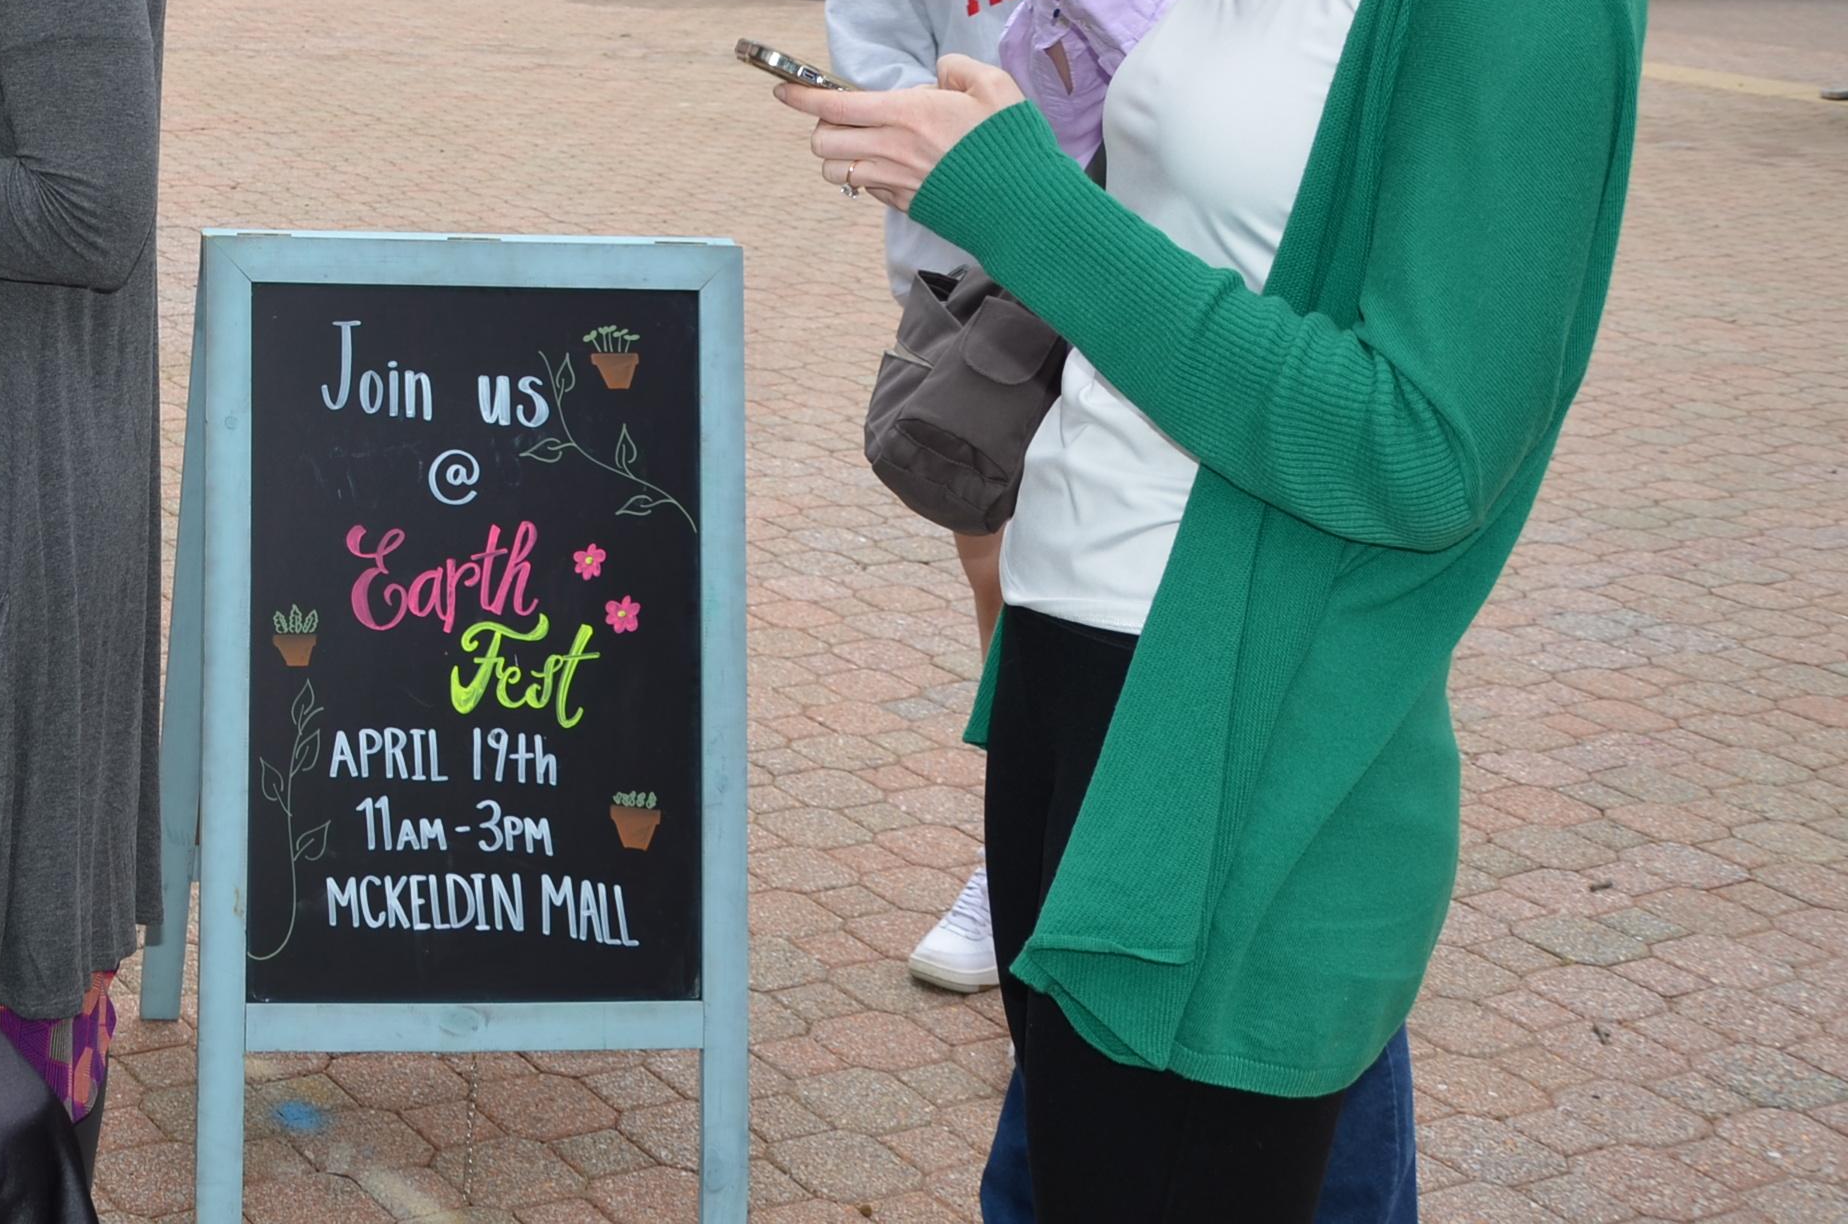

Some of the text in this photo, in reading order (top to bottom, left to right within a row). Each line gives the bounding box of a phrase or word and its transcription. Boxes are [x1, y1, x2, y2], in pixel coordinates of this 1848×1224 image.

[321, 320, 551, 428] Join us
[428, 449, 480, 505] @
[346, 520, 539, 633] Earth
[451, 613, 600, 729] Fest
[329, 727, 557, 786] APRIL 19th
[326, 873, 640, 946] MCKELDIN MALL
